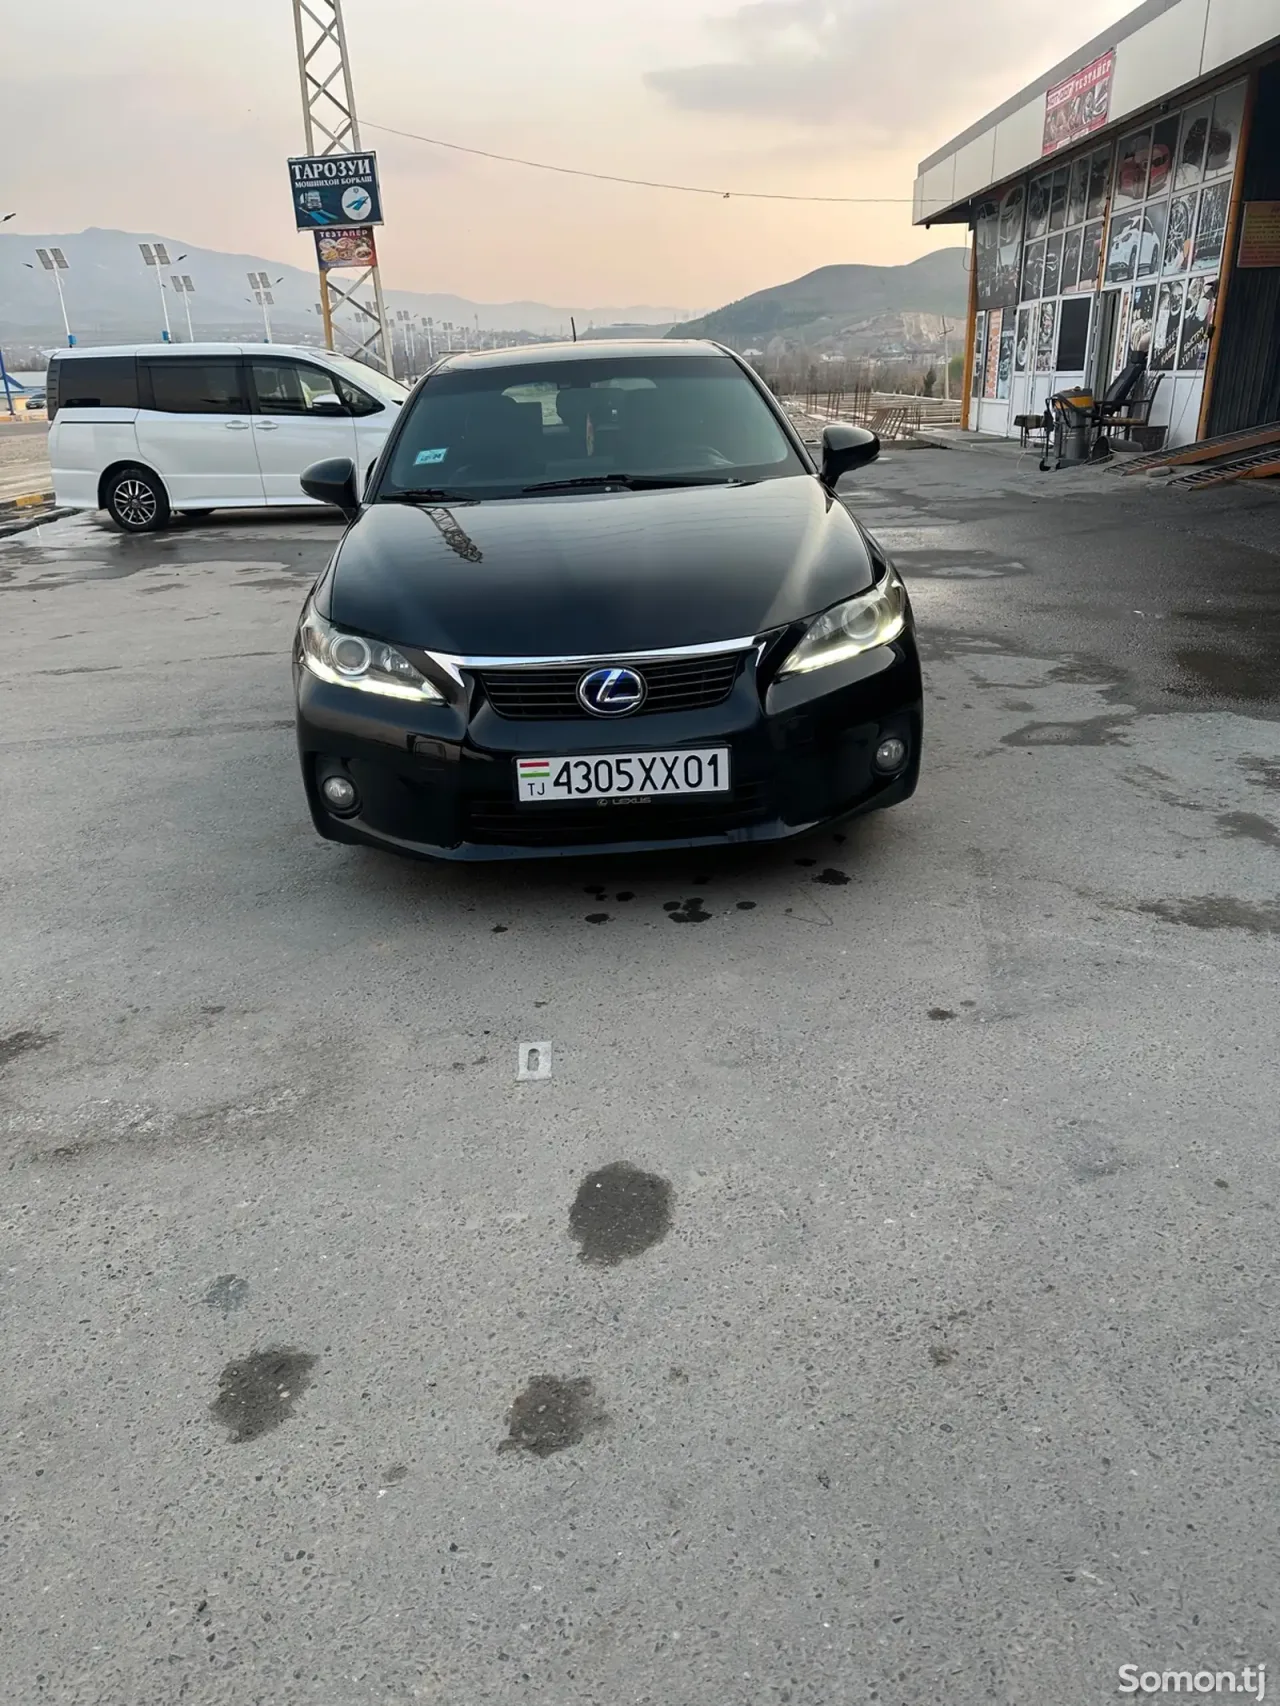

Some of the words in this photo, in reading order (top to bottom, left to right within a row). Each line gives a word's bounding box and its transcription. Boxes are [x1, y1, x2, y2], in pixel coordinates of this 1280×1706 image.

[292, 159, 371, 179] ТАРОЗУИ
[341, 176, 372, 185] БОРКАШ
[527, 782, 545, 797] TJ
[553, 753, 719, 795] 4305XX01
[612, 796, 652, 805] LEXUS
